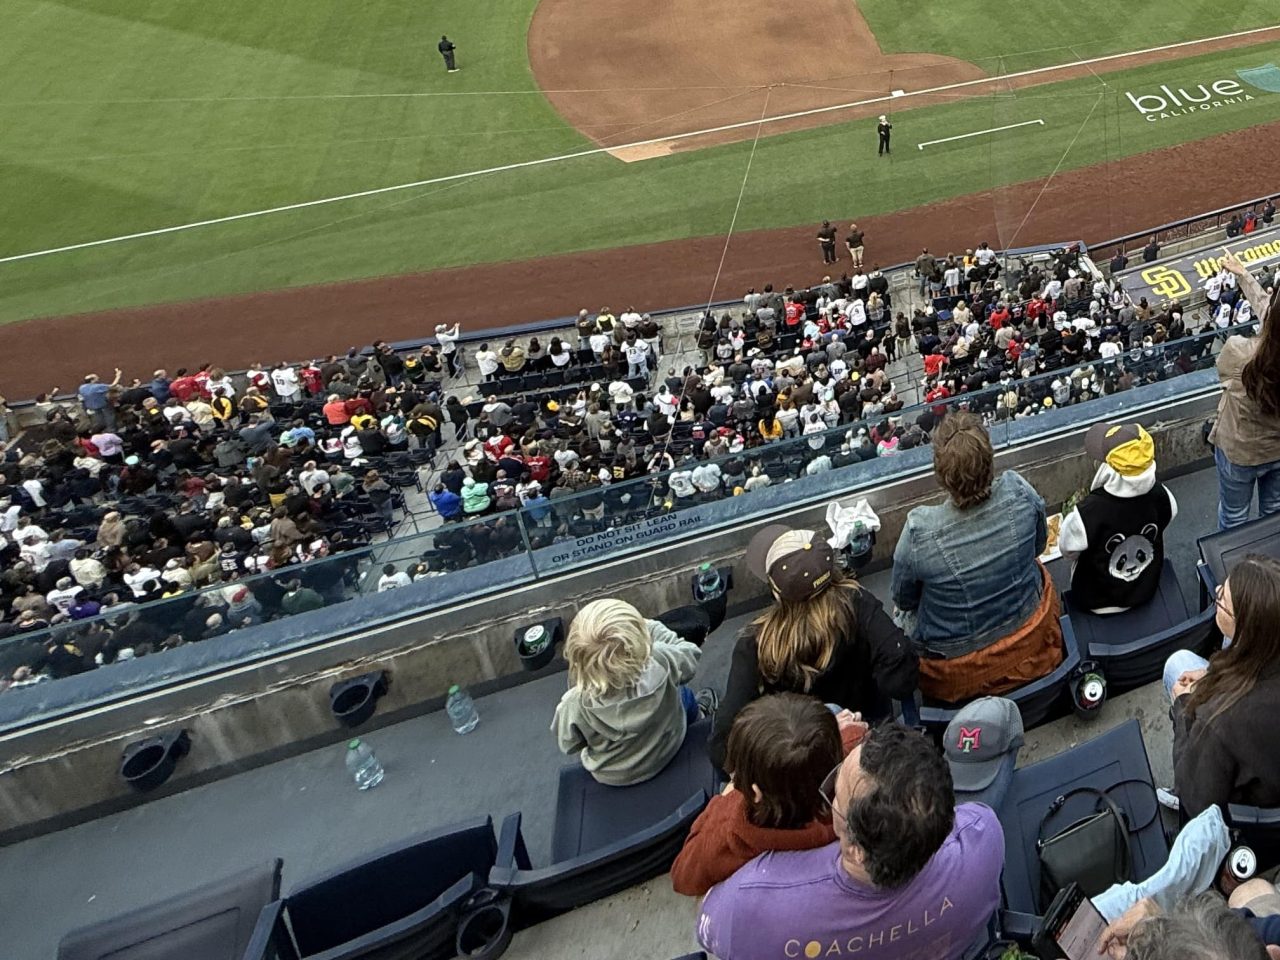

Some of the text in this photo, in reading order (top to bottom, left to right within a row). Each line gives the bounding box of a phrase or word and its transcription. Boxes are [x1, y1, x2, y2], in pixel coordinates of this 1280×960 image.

[1125, 79, 1244, 114] blue
[1145, 94, 1254, 122] CALIFORNIA
[1141, 265, 1192, 299] SD
[552, 515, 702, 563] OR STAND ON GUARD RAIL
[577, 513, 677, 547] DO NOT SIT LEAN
[784, 896, 953, 958] COACHELLA
